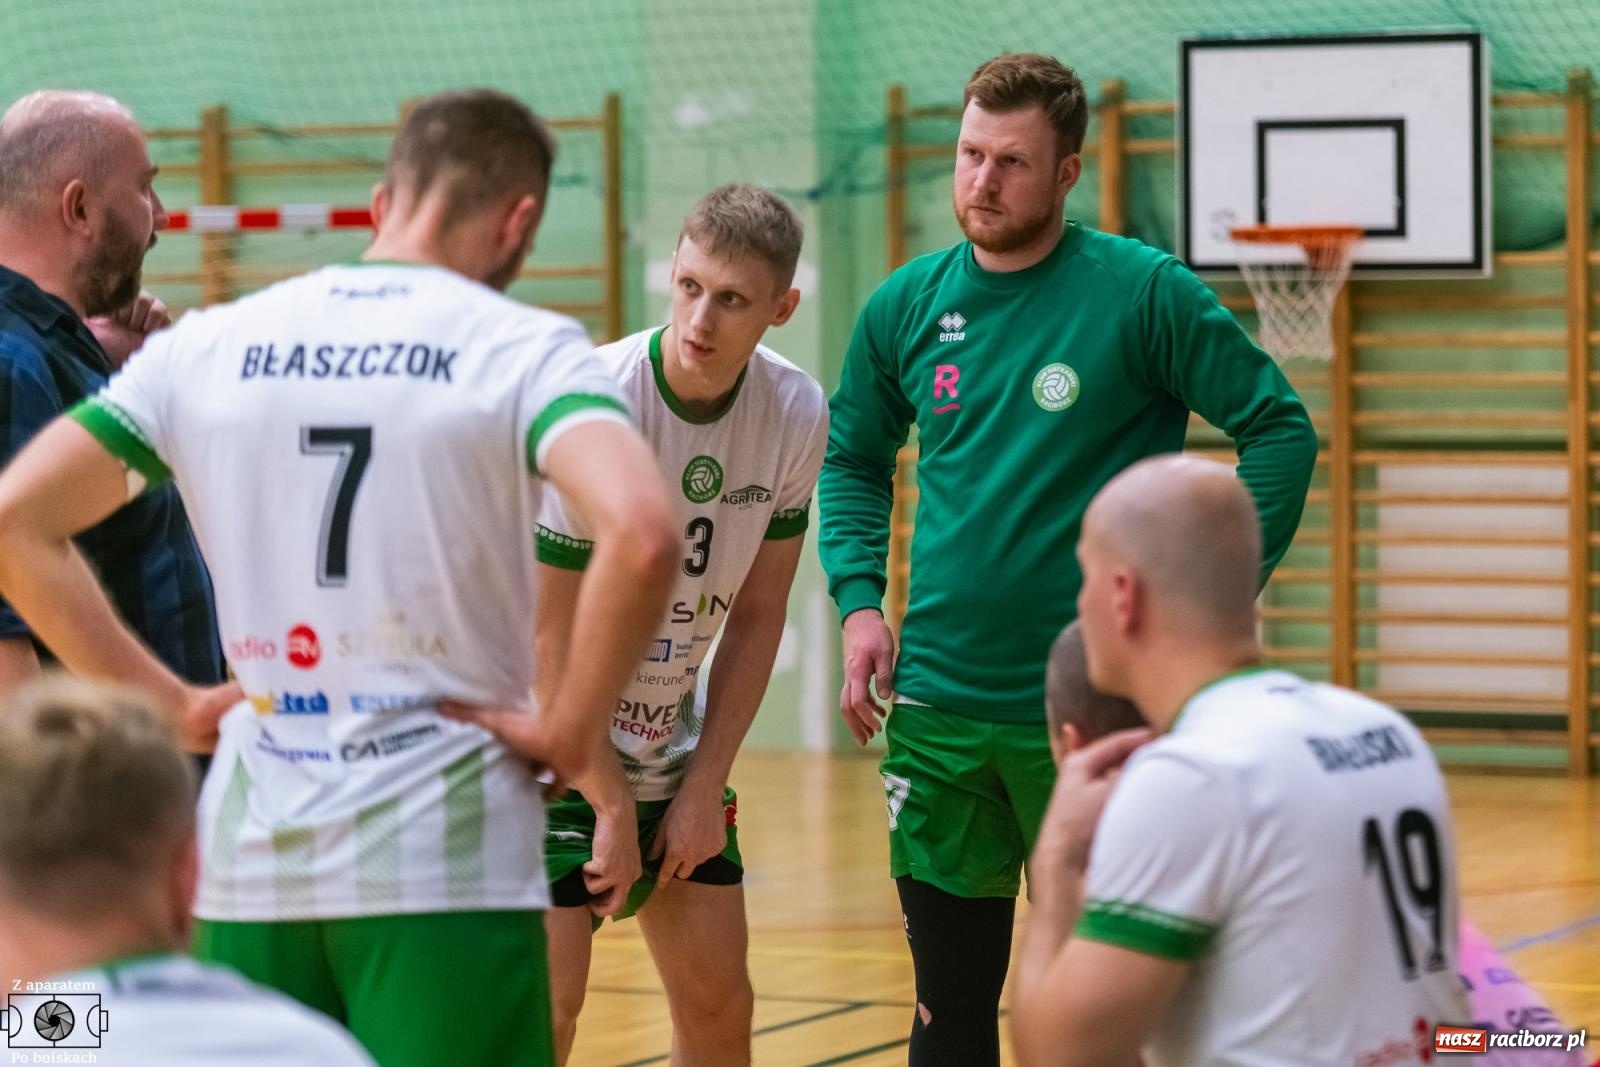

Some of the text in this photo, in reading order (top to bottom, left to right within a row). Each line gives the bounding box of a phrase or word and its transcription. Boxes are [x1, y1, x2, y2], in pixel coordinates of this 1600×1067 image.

[939, 331, 966, 343] errea
[241, 343, 459, 383] BŁASZCZOK
[933, 364, 961, 400] R
[301, 424, 374, 587] 7
[682, 516, 714, 578] 3
[1362, 808, 1447, 981] 19
